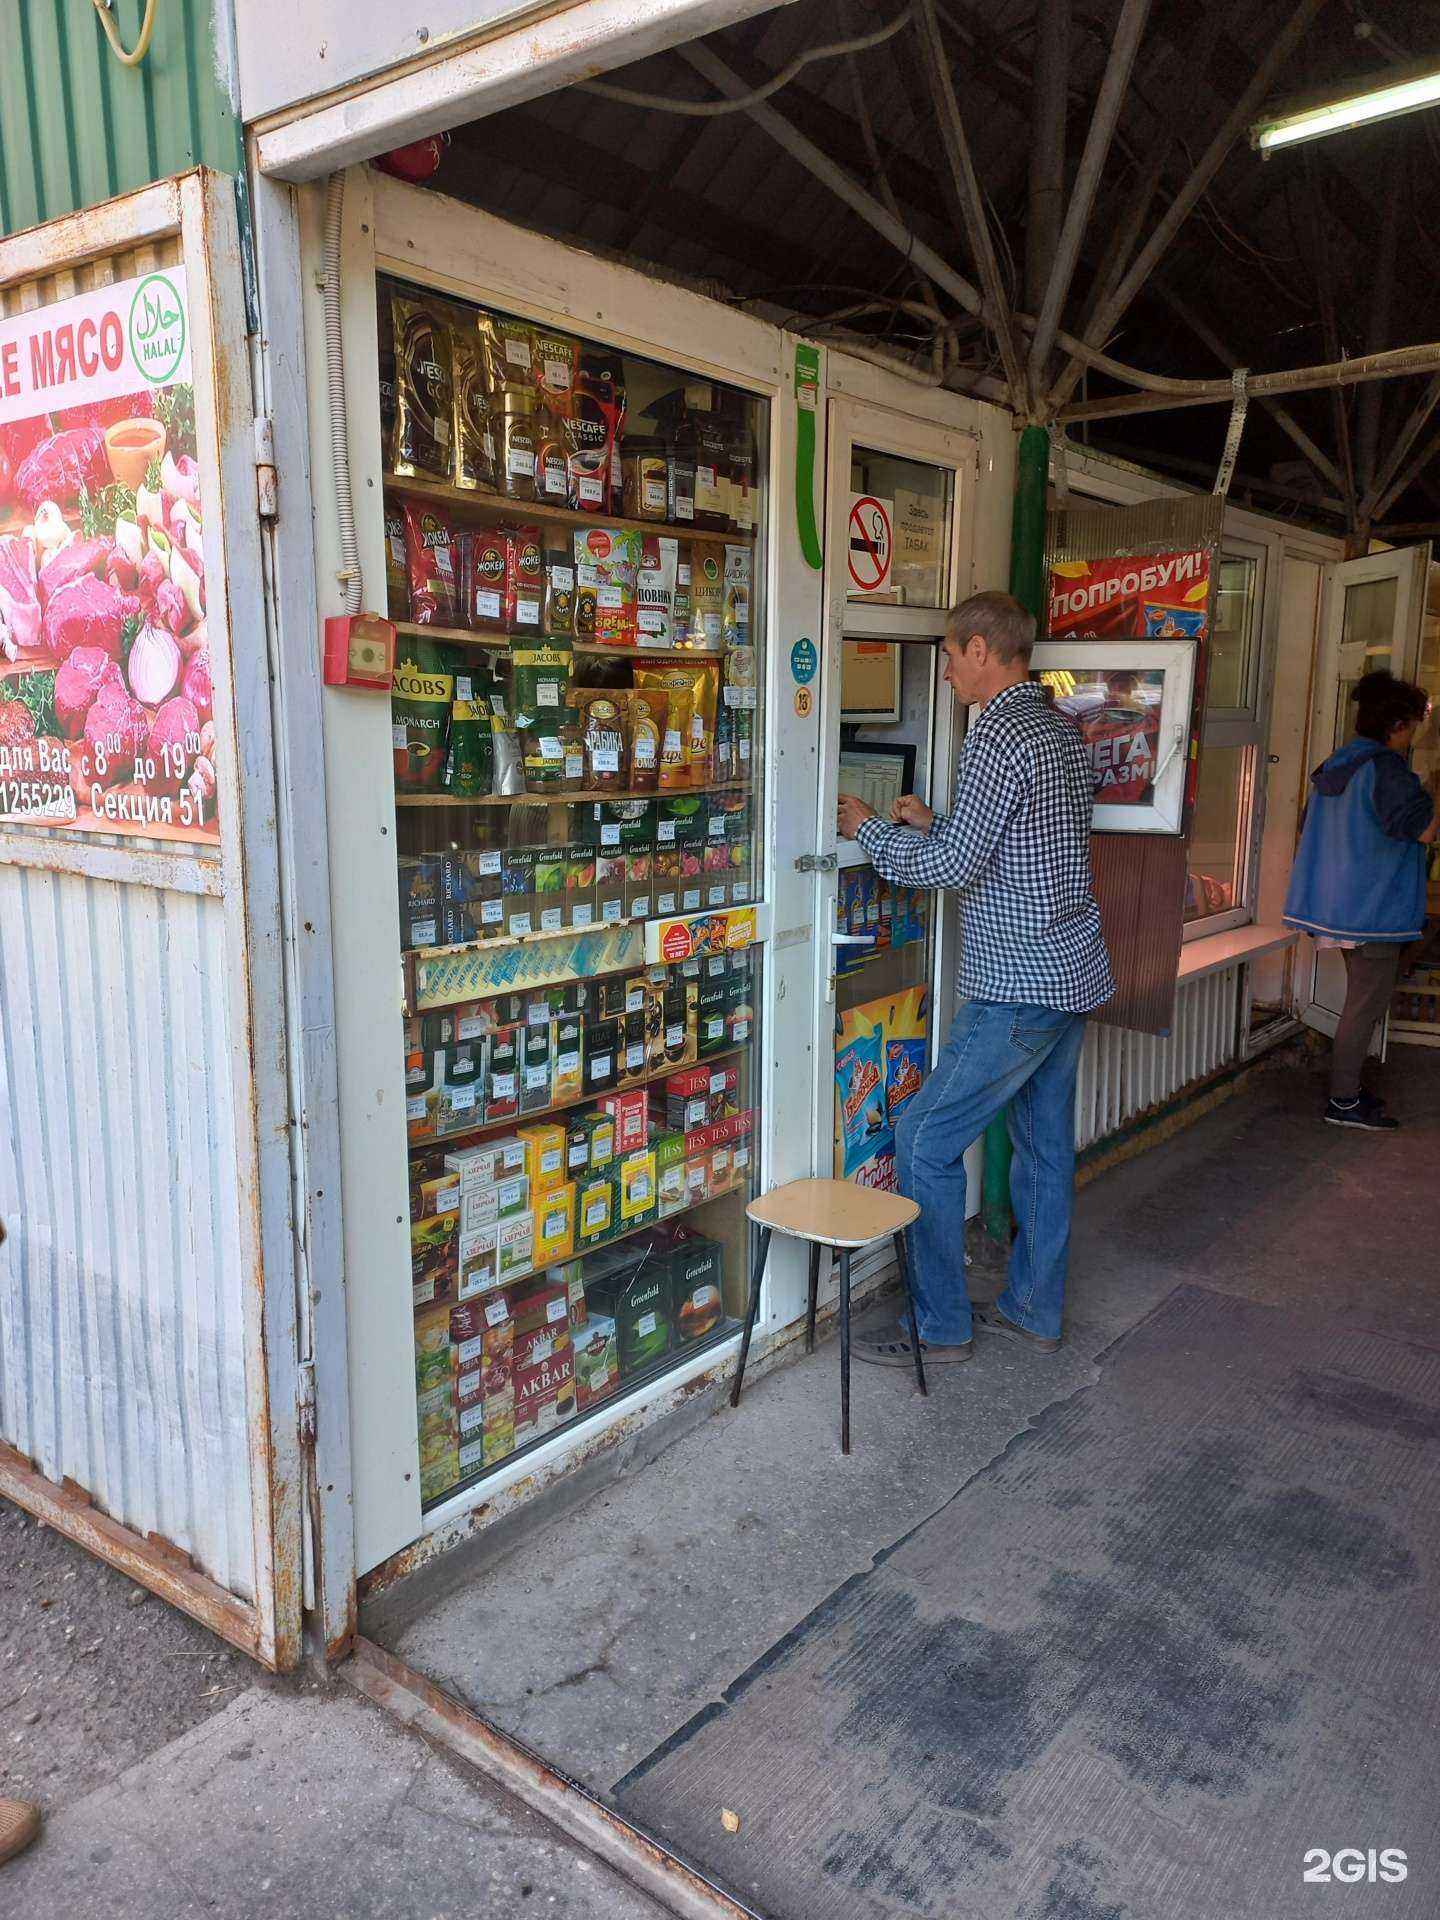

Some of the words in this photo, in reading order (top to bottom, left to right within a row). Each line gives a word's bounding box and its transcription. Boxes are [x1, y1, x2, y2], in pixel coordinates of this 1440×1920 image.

[0, 341, 22, 400] Е
[29, 311, 124, 391] МЯСО
[143, 337, 177, 361] HALAL
[1052, 552, 1202, 618] ПОПРОБУЙ!
[532, 653, 561, 663] JACOBS
[391, 675, 446, 697] ACOBS
[395, 713, 440, 730] MONARCH
[0, 746, 34, 776] для
[38, 740, 72, 774] Вас
[133, 757, 156, 785] до
[91, 782, 173, 829] Секция
[179, 787, 204, 827] 51
[538, 851, 563, 862] Greenfield
[408, 898, 436, 908] RICHARD
[701, 990, 724, 1005] Greenfield
[689, 1075, 708, 1093] TESS
[734, 1117, 752, 1133] TESS
[688, 1134, 707, 1151] TESS
[712, 1127, 730, 1142] TESS
[664, 1143, 682, 1156] TESS
[686, 1257, 713, 1281] Greenfield
[630, 1282, 660, 1308] Greenfield
[520, 1360, 572, 1400] AKBAR
